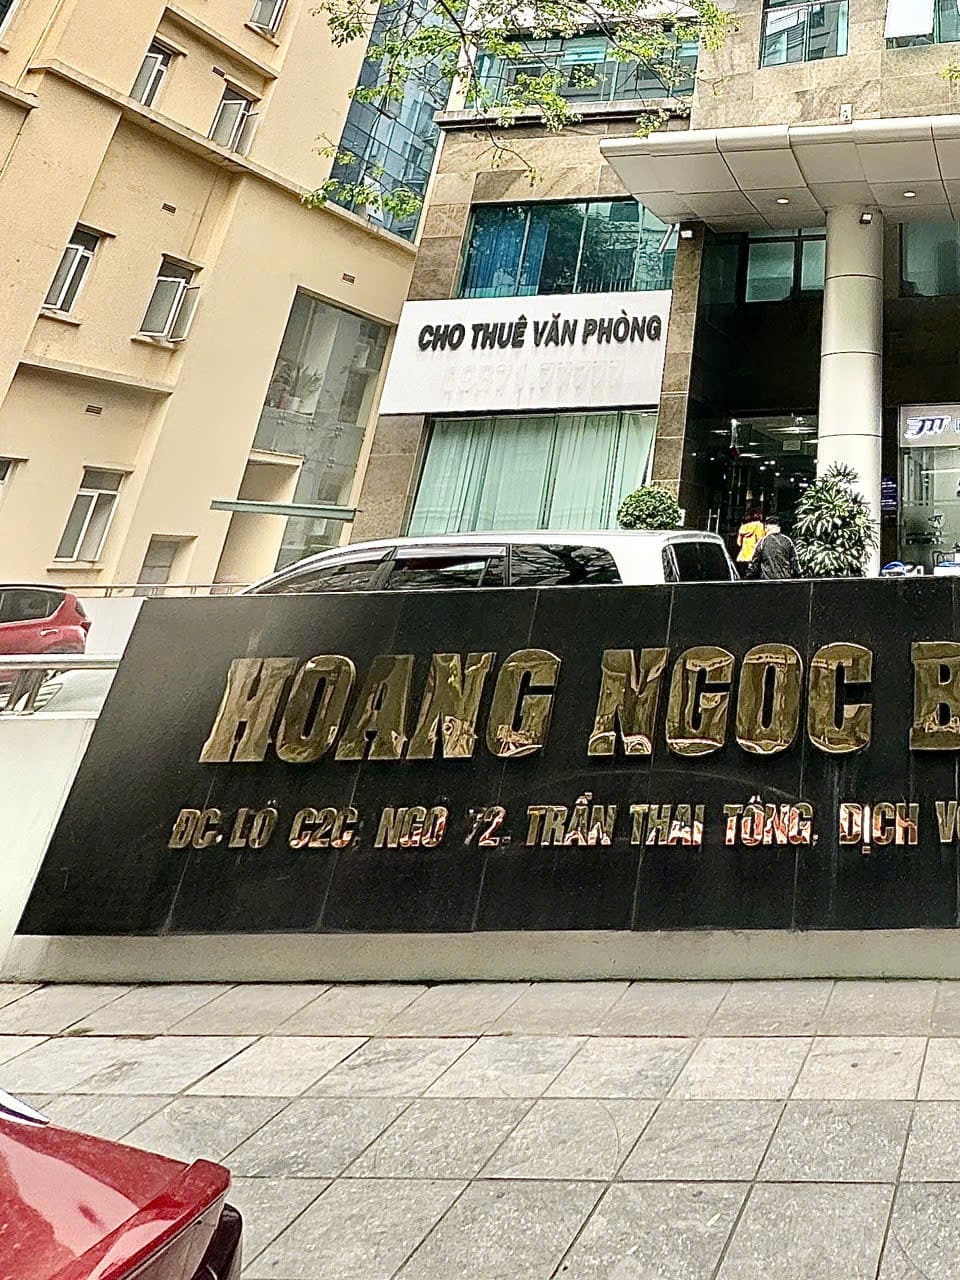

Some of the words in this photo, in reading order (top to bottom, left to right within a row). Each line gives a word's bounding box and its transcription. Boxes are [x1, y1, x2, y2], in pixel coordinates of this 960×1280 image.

[417, 323, 465, 352] CHO
[470, 314, 529, 350] THUÊ
[532, 312, 579, 347] VĂN
[582, 309, 662, 345] PHÒNG
[198, 647, 563, 765] HOANG
[586, 641, 874, 758] NGOC
